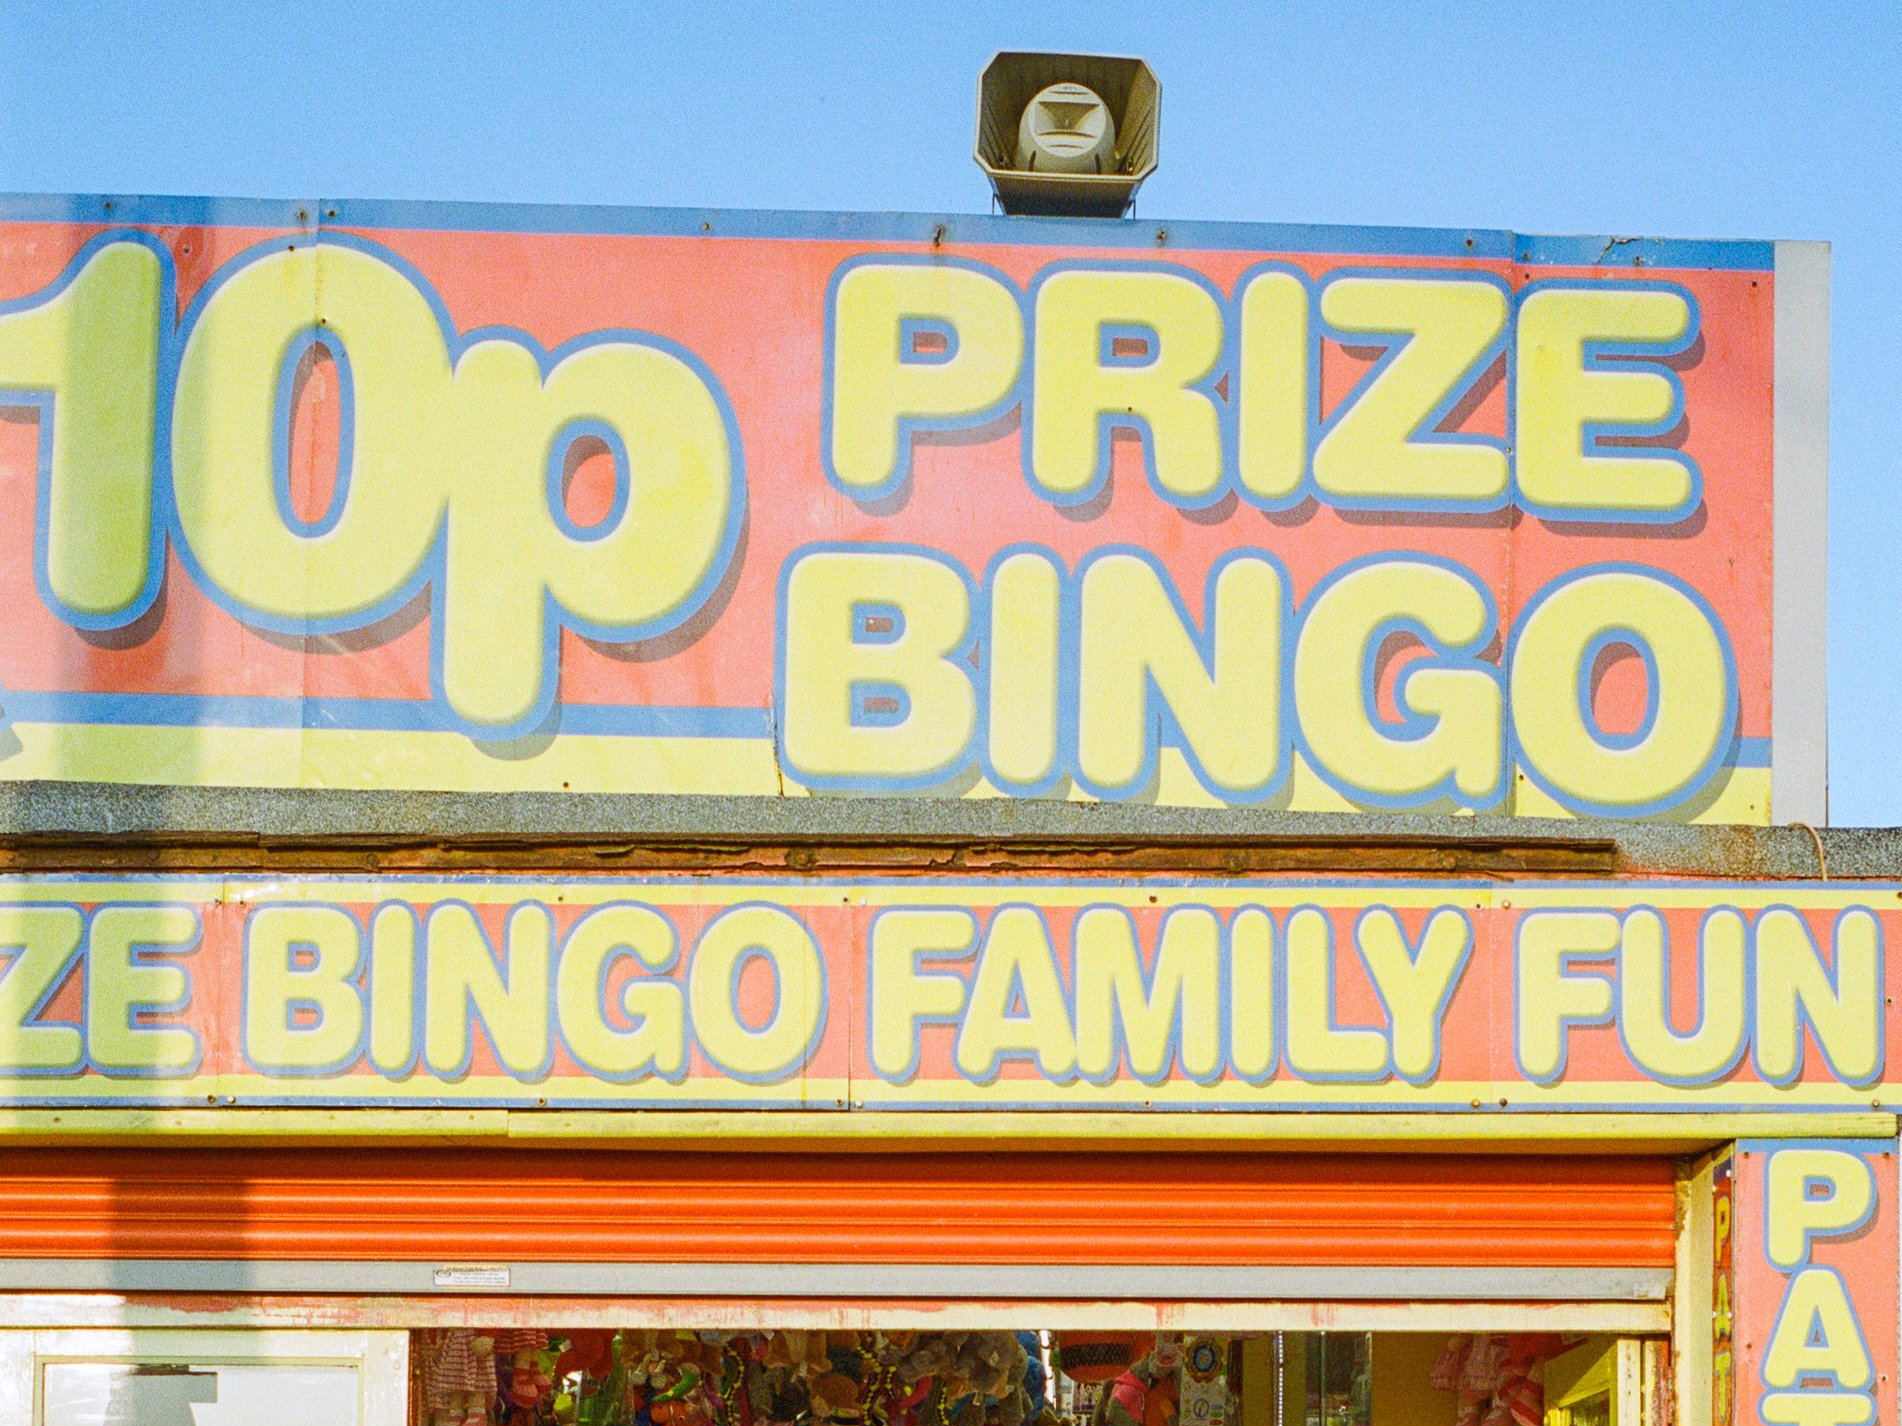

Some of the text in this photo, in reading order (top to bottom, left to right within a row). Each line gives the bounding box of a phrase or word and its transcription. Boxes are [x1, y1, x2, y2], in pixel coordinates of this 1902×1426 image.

[0, 240, 738, 730] 10p
[826, 259, 1701, 514] PRIZE
[781, 548, 1736, 806] BINGO
[244, 901, 825, 1080] BINGO
[868, 905, 1474, 1083] FAMILY
[1516, 905, 1886, 1086] FUN
